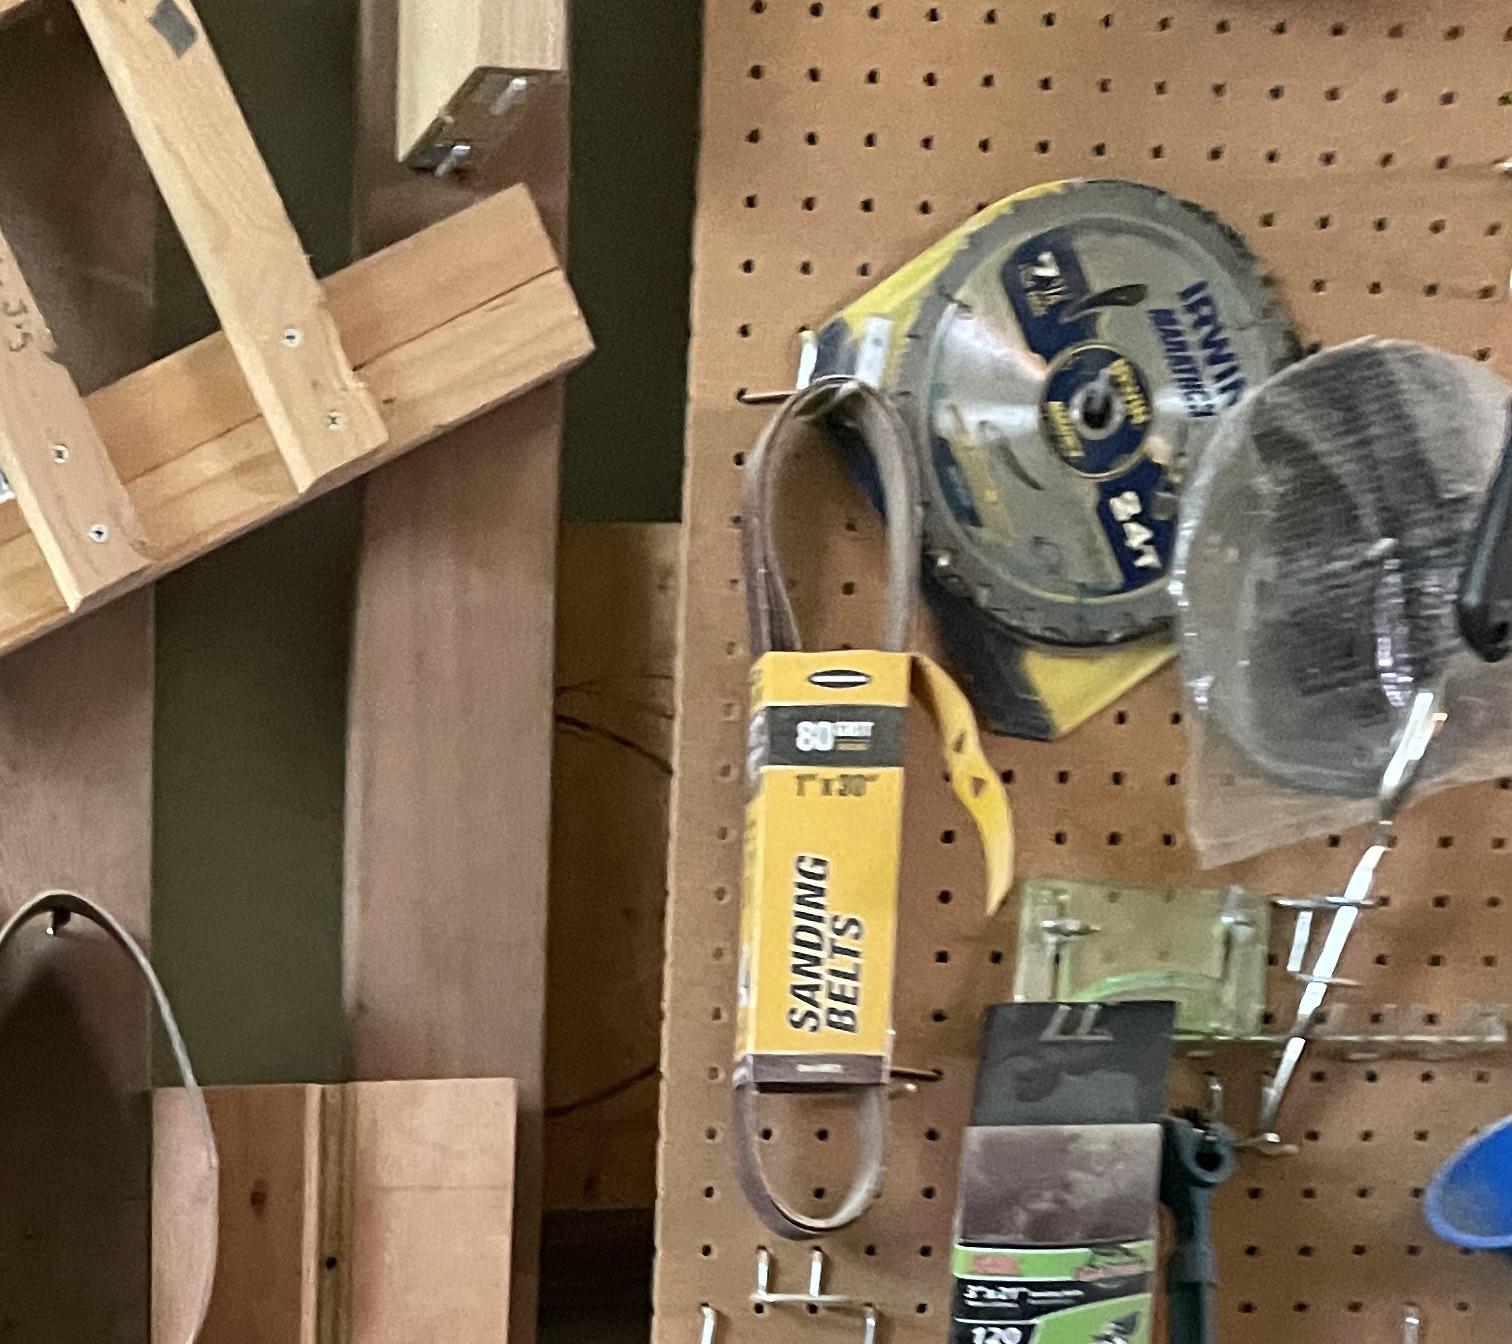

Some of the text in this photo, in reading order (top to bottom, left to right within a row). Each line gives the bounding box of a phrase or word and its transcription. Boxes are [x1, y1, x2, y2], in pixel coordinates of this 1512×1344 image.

[795, 721, 835, 751] 80
[788, 855, 830, 1033] SANDING
[825, 914, 864, 1034] BELTS
